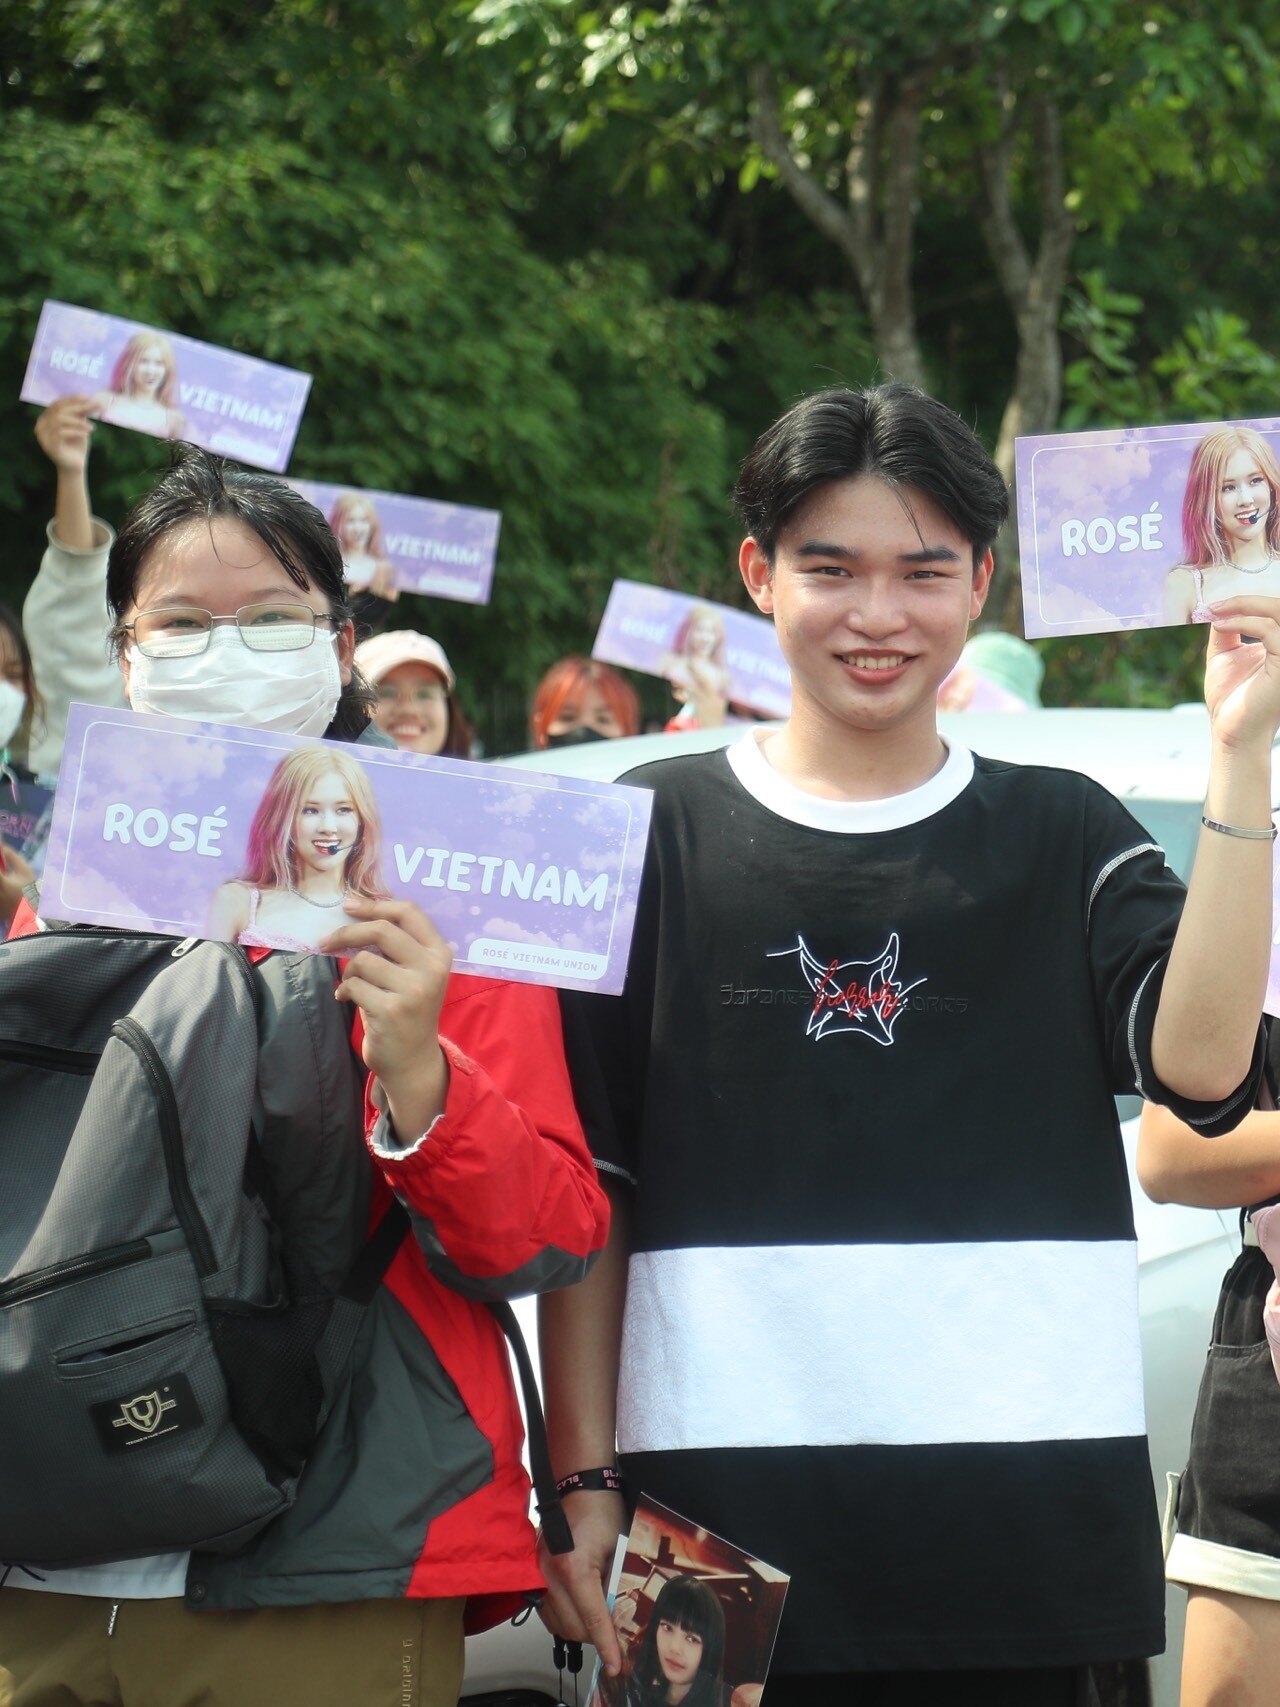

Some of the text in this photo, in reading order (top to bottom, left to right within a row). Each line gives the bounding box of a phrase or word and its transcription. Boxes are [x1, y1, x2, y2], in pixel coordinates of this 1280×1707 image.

[50, 347, 284, 432] ROSÉ VIETNAM
[385, 533, 482, 567] VIETNAM
[1060, 501, 1164, 557] ROSÉ
[103, 803, 608, 912] ROSÉ VIETNAM
[482, 947, 598, 972] ROSÉ VIETNAM UNION
